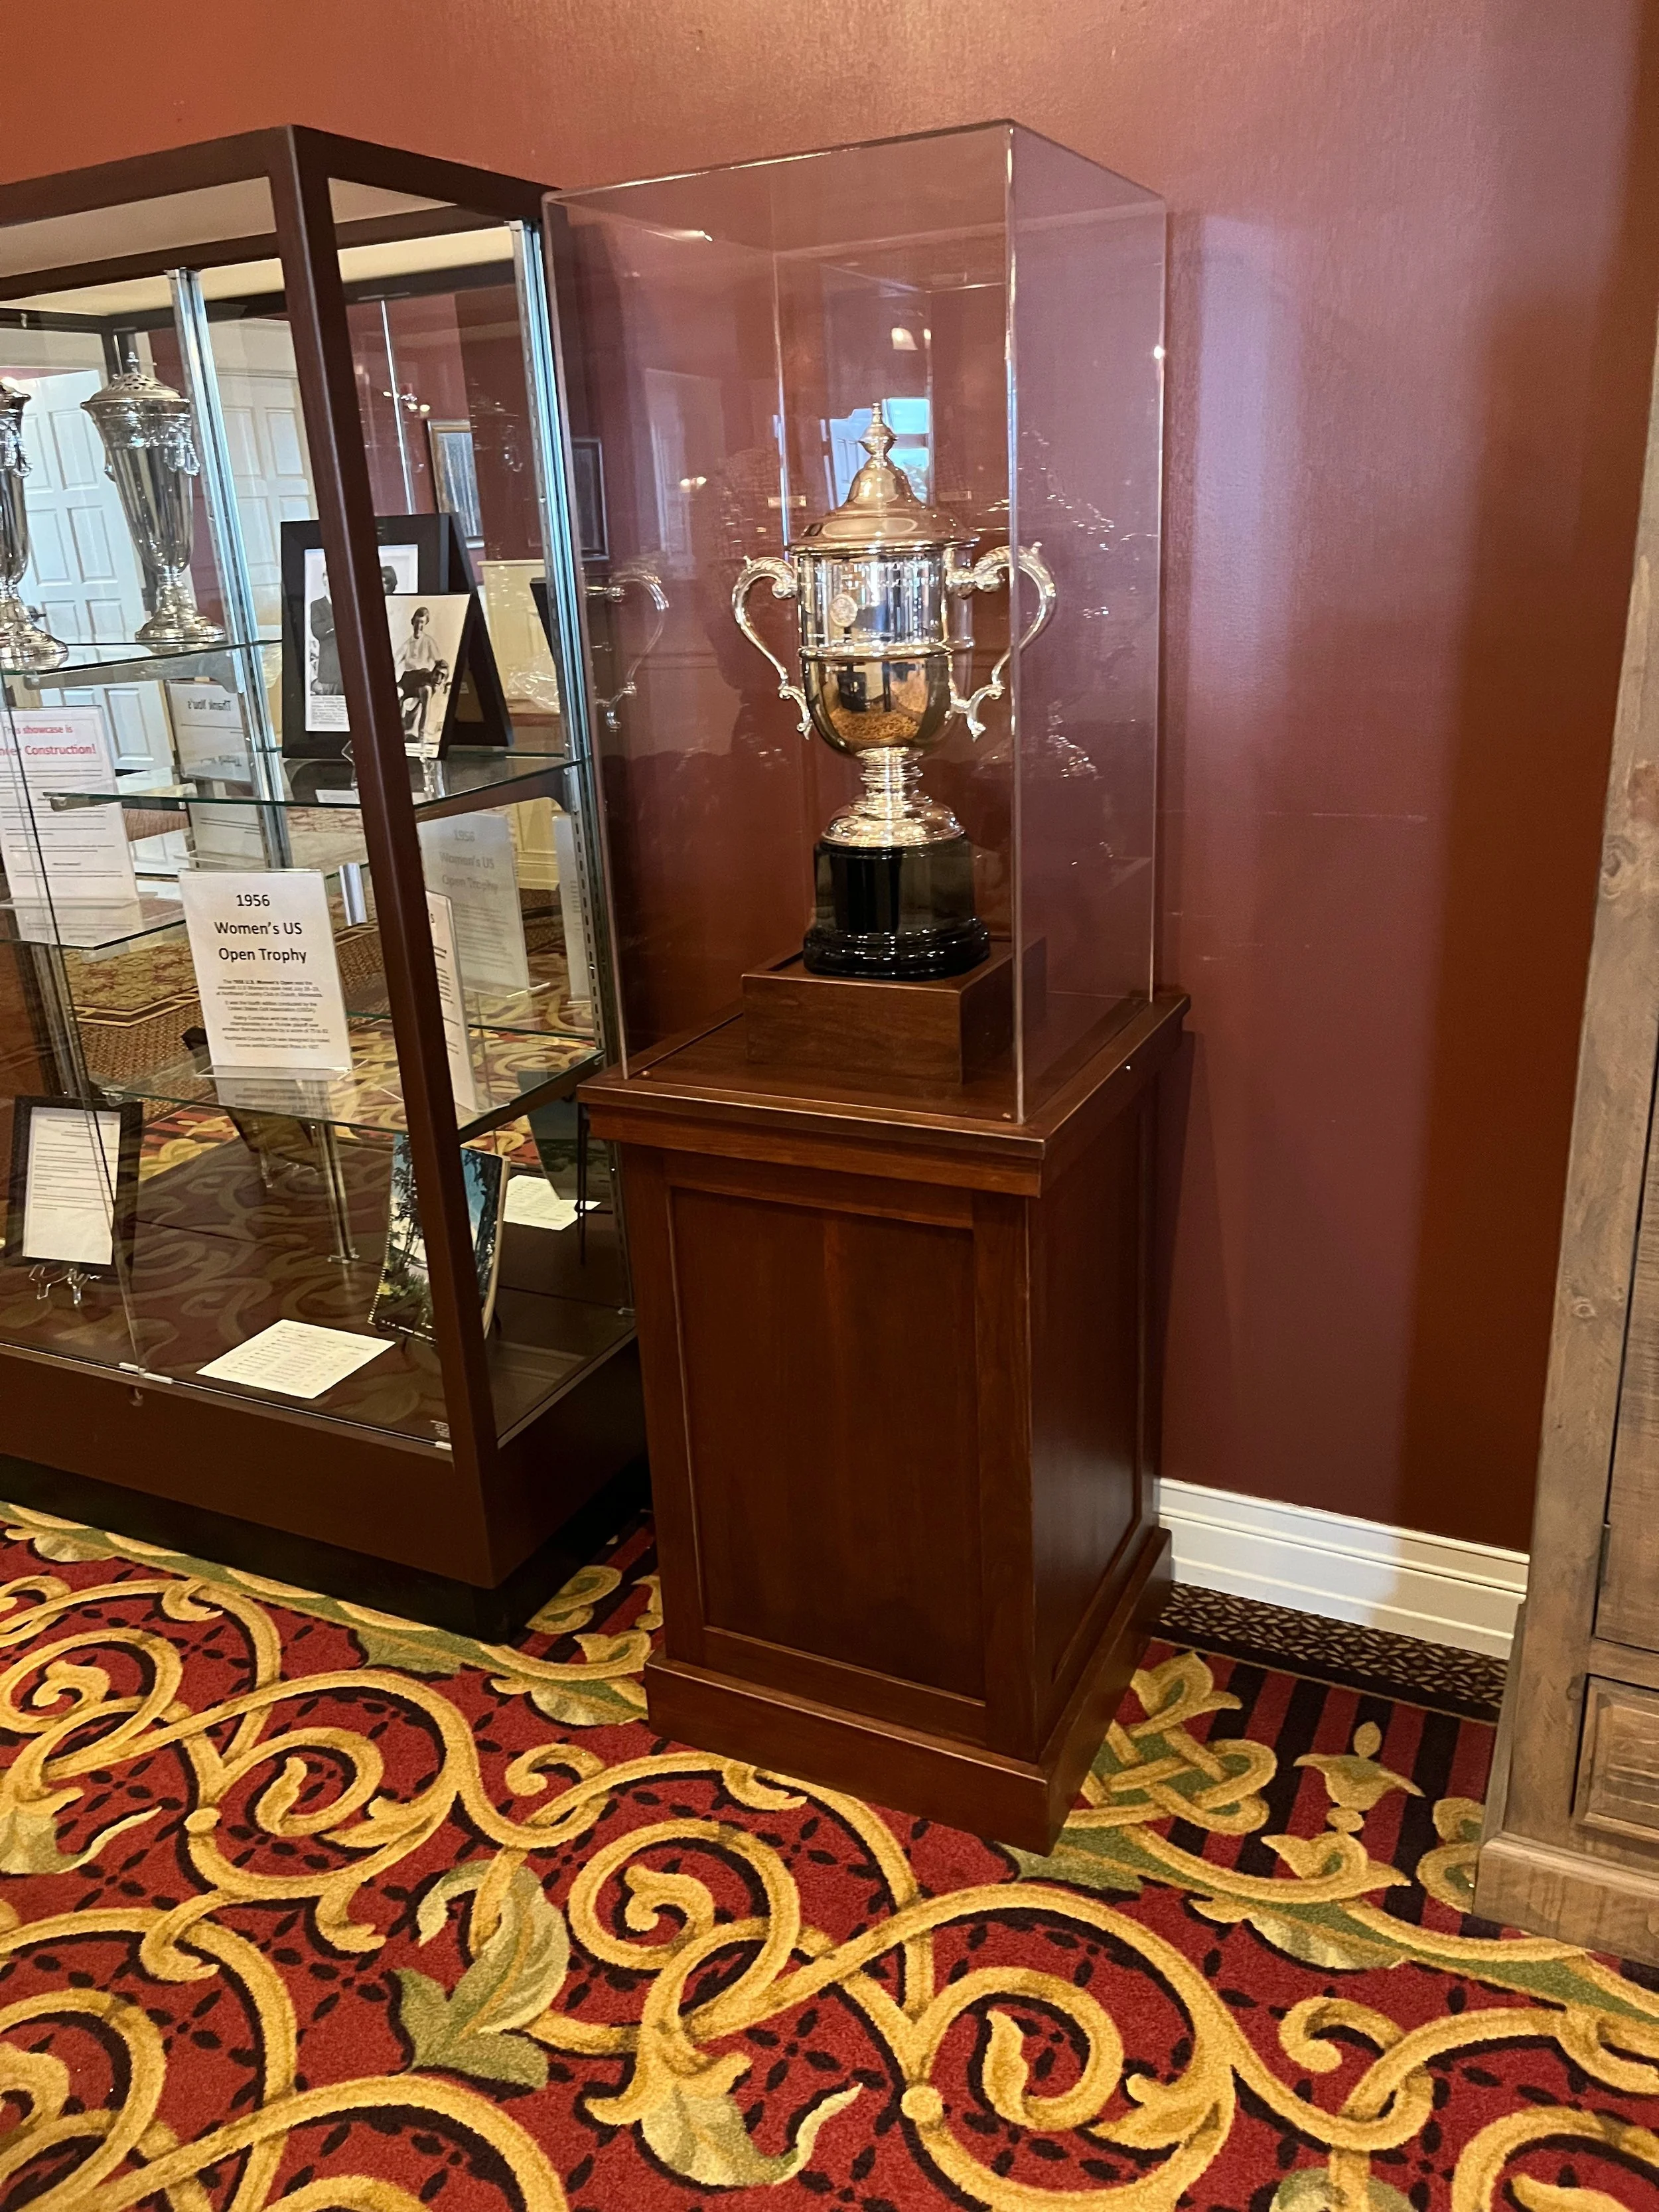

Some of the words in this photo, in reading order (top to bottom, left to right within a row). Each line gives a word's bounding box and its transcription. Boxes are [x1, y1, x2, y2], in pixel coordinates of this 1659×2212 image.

[65, 724, 73, 733] is
[25, 743, 97, 755] Construction!
[236, 894, 271, 907] 1956
[214, 921, 279, 934] Women's
[283, 922, 303, 934] US
[218, 948, 255, 962] Open
[258, 948, 307, 964] Trophy
